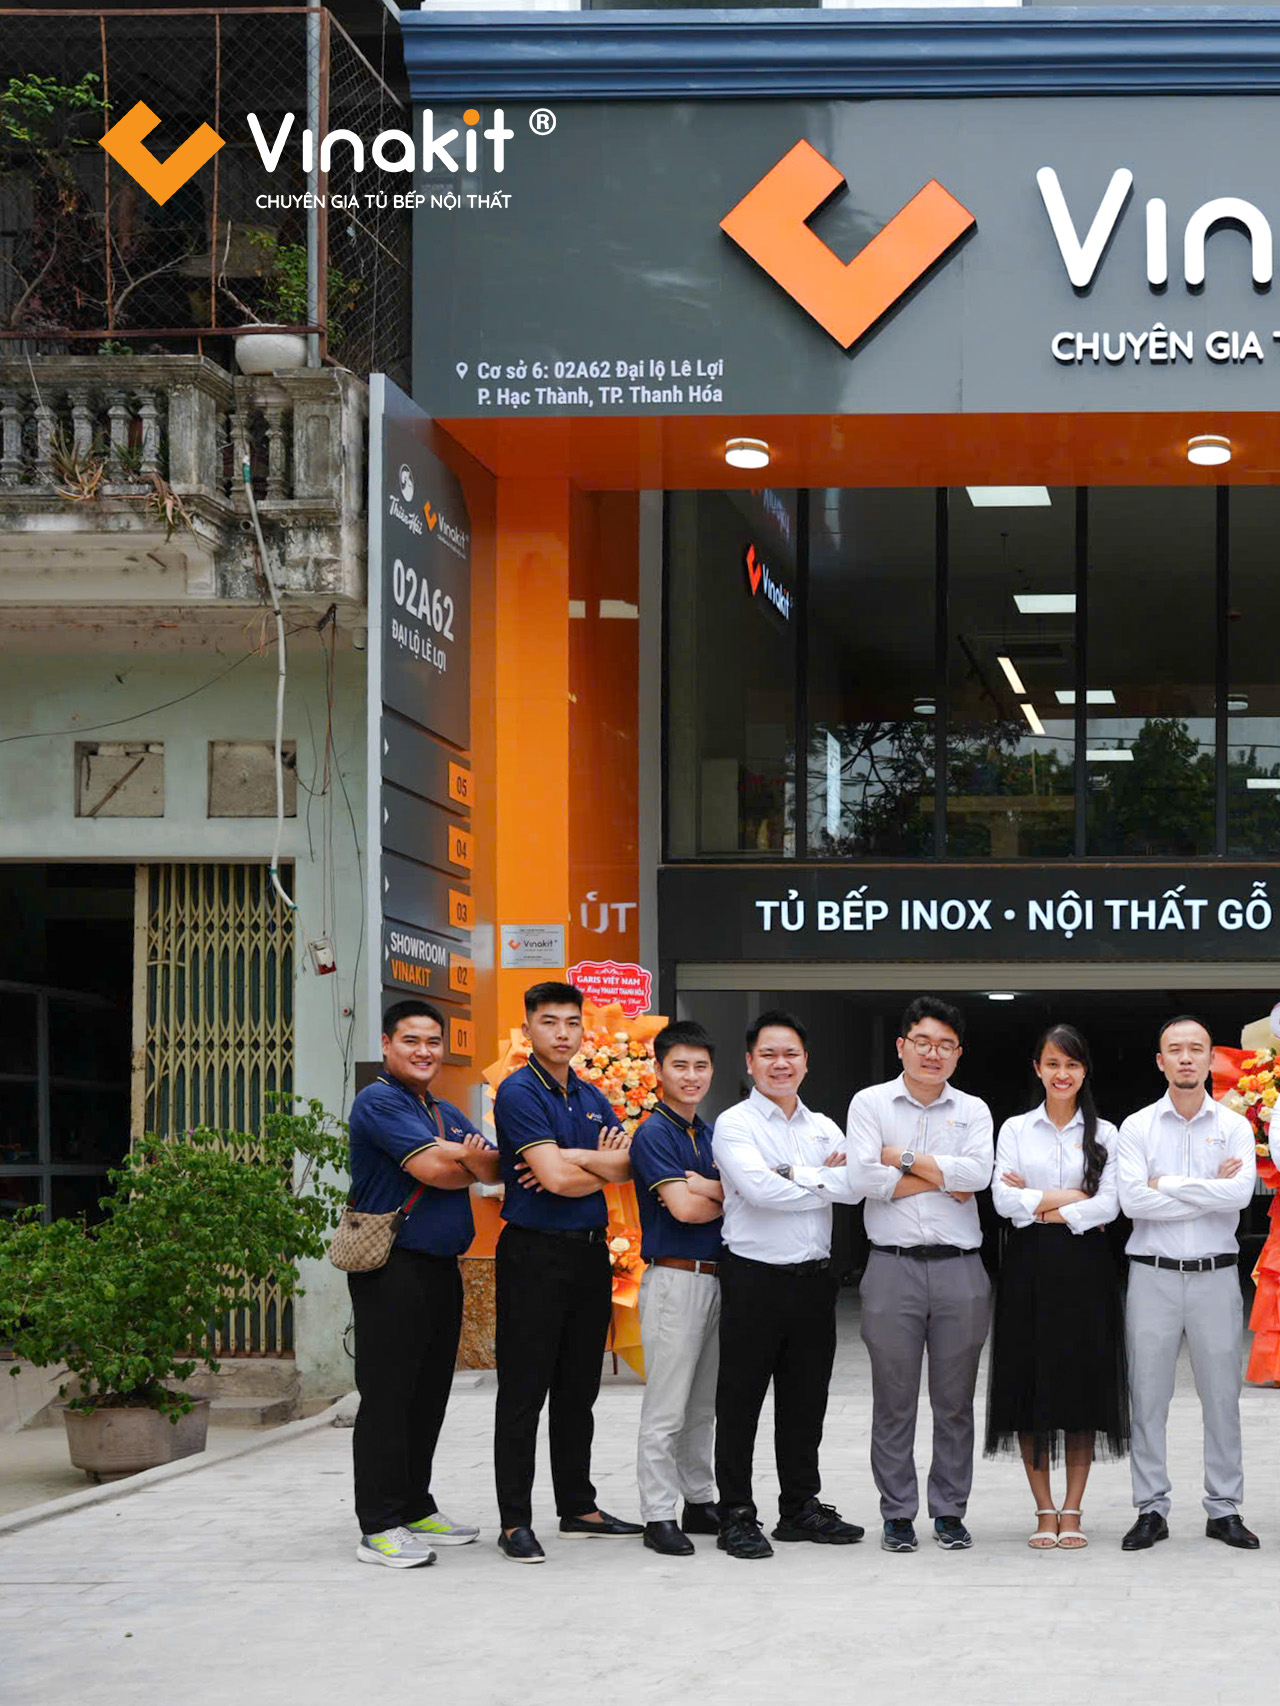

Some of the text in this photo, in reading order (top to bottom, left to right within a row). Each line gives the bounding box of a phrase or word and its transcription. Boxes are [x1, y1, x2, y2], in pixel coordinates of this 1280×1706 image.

[1051, 323, 1193, 363] CHUYÊN
[1205, 330, 1264, 362] GIA
[477, 359, 724, 381] Cơ sở 6: 02A62 Đại lộ Lê Lợi
[477, 385, 723, 409] P. Hạc Thành, TP. Thanh Hóa
[392, 558, 454, 642] 02A62
[392, 618, 446, 674] ĐẠI LỘ LÊ LỢI
[456, 775, 468, 797] 05
[456, 839, 467, 860] 04
[456, 903, 468, 923] 03
[755, 880, 1273, 940] TỦ BẾP INOX NỘI THẤT GỖ
[390, 931, 446, 967] SHOWROOM
[391, 958, 432, 988] VINAKIT
[457, 966, 468, 985] 02
[577, 975, 641, 986] GARIS VIỆT NAM
[457, 1029, 467, 1048] 01
